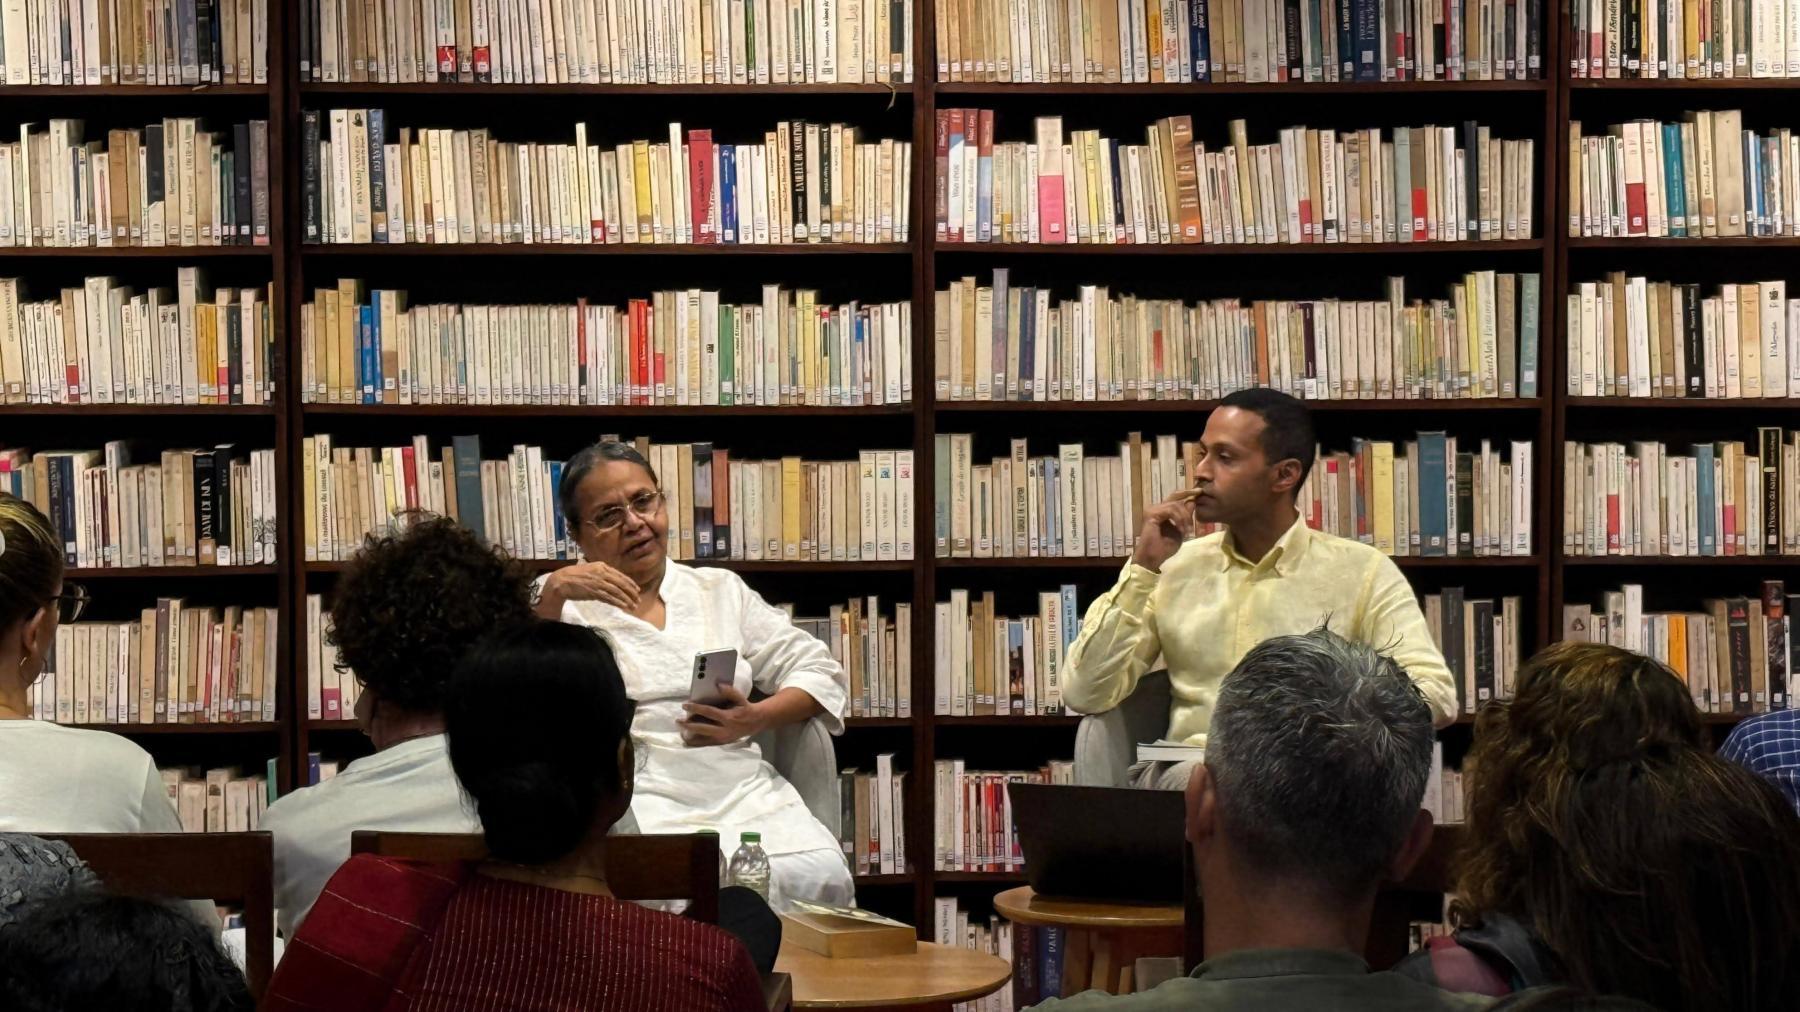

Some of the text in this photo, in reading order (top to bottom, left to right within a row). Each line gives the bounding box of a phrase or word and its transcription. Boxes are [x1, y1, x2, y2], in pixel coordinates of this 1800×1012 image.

[793, 122, 803, 151] SCORPION
[793, 152, 804, 161] DU
[794, 162, 804, 183] QUEUE
[794, 182, 805, 192] LA
